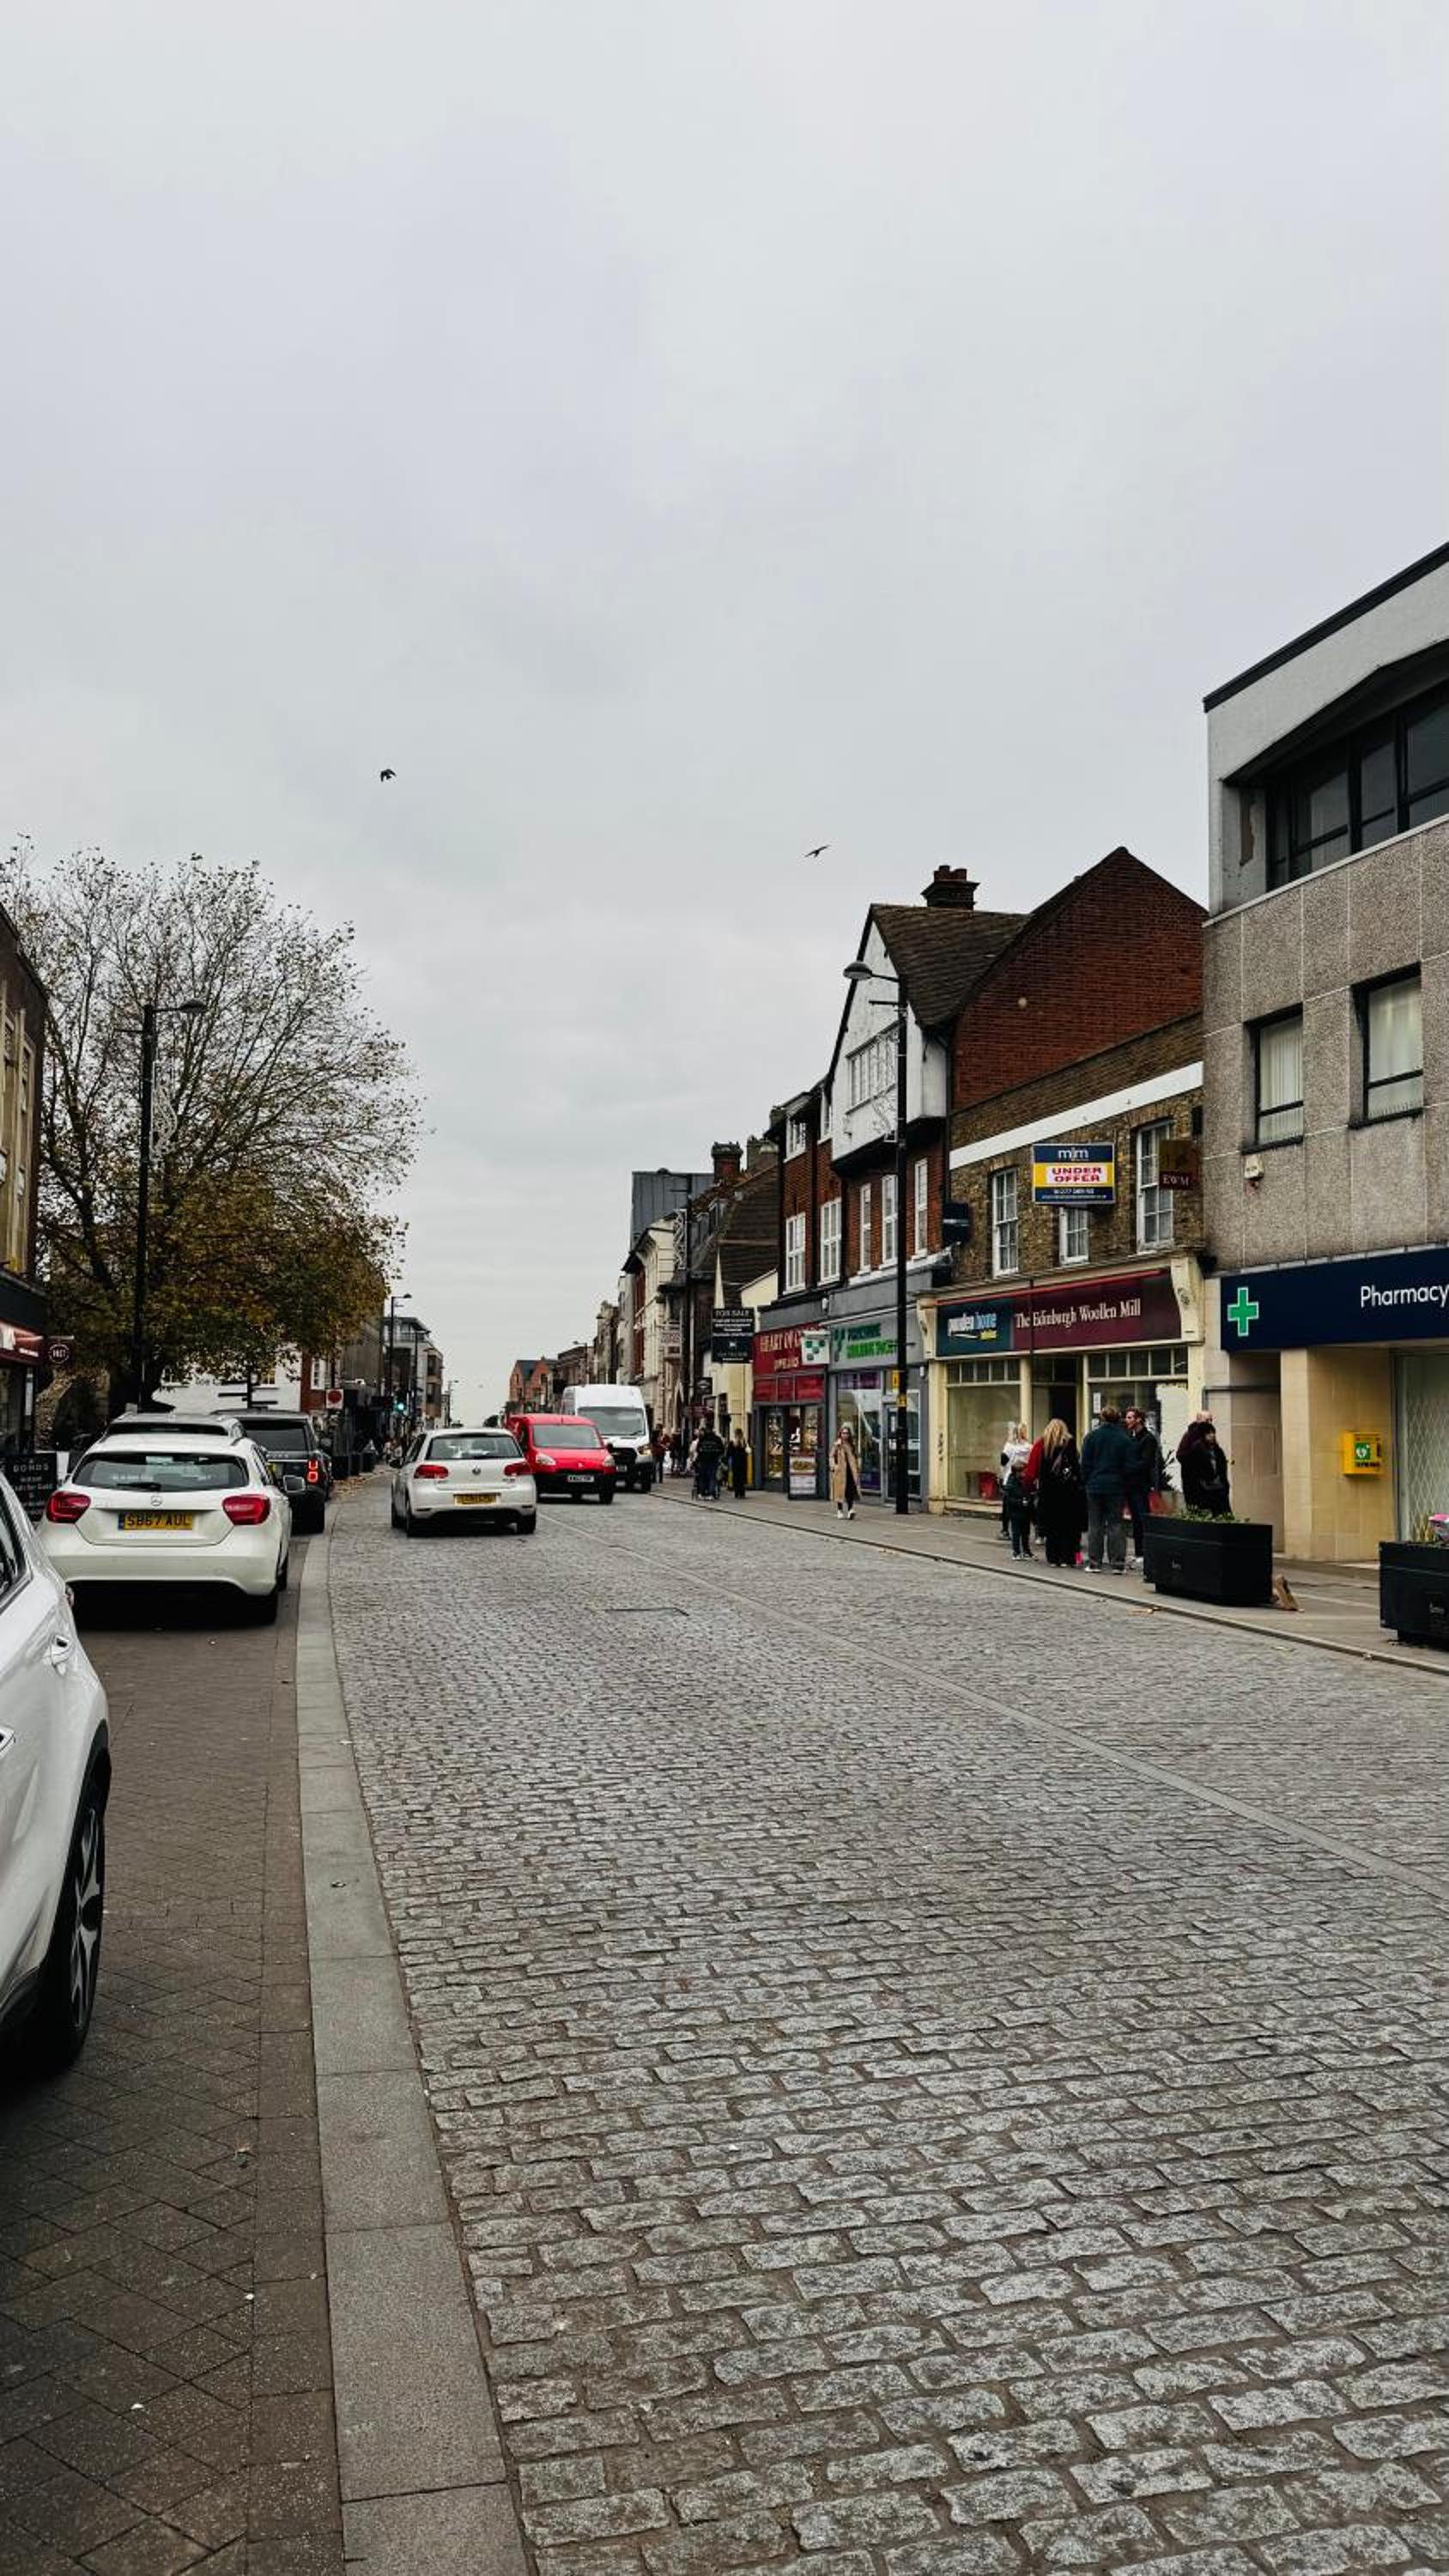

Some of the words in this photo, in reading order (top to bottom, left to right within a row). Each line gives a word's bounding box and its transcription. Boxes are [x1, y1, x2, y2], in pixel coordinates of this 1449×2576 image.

[1361, 1285, 1449, 1308] Pharmacy
[1016, 1313, 1030, 1328] The
[1033, 1306, 1076, 1328] Edinburgh
[1079, 1303, 1117, 1321] Woollen
[1119, 1297, 1141, 1317] Mill
